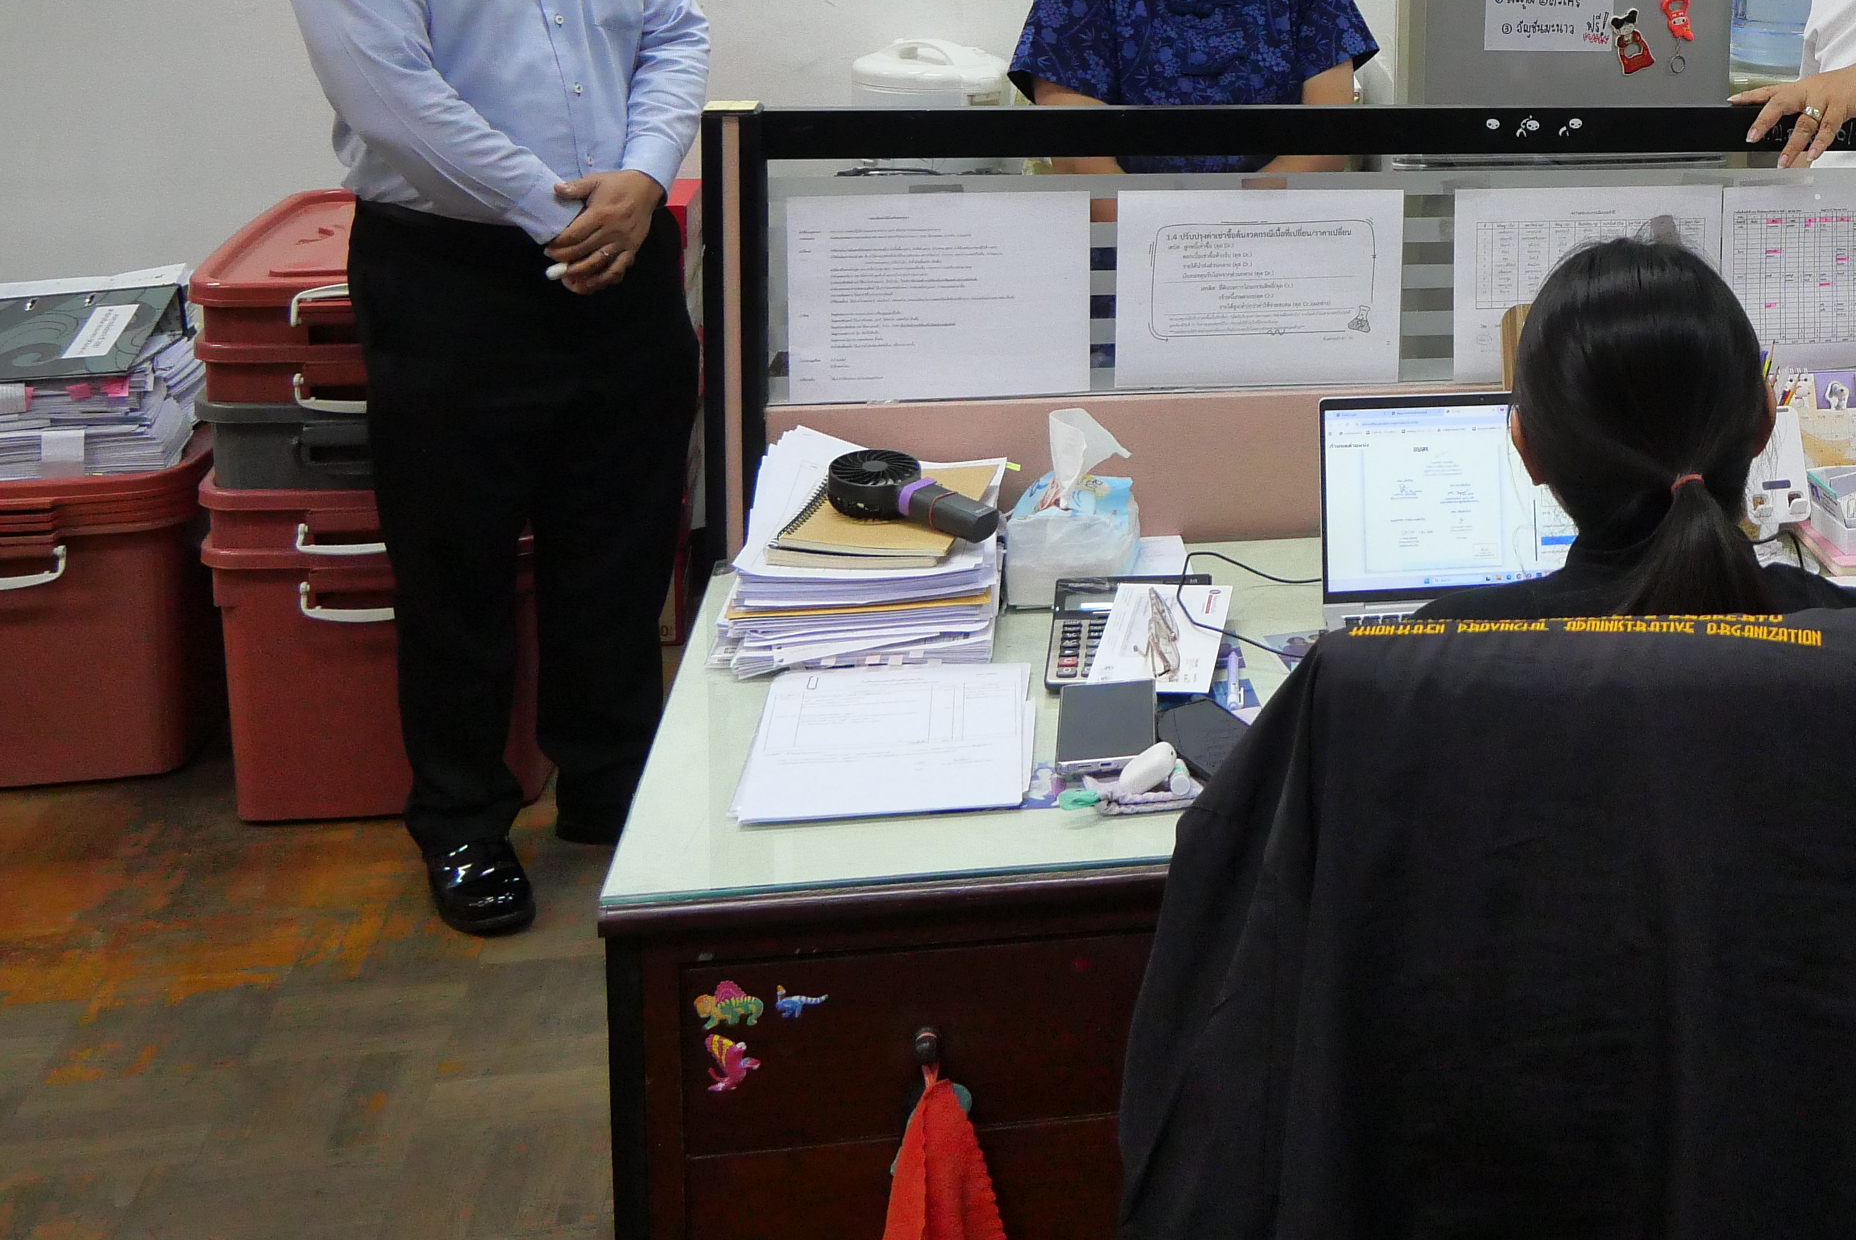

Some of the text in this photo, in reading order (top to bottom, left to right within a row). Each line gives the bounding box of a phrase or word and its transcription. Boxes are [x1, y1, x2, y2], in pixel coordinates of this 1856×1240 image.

[1457, 621, 1549, 634] PROVINCIAL
[1563, 620, 1695, 634] ADMINISTRATIVE
[1706, 622, 1822, 647] ORGANIZATION
